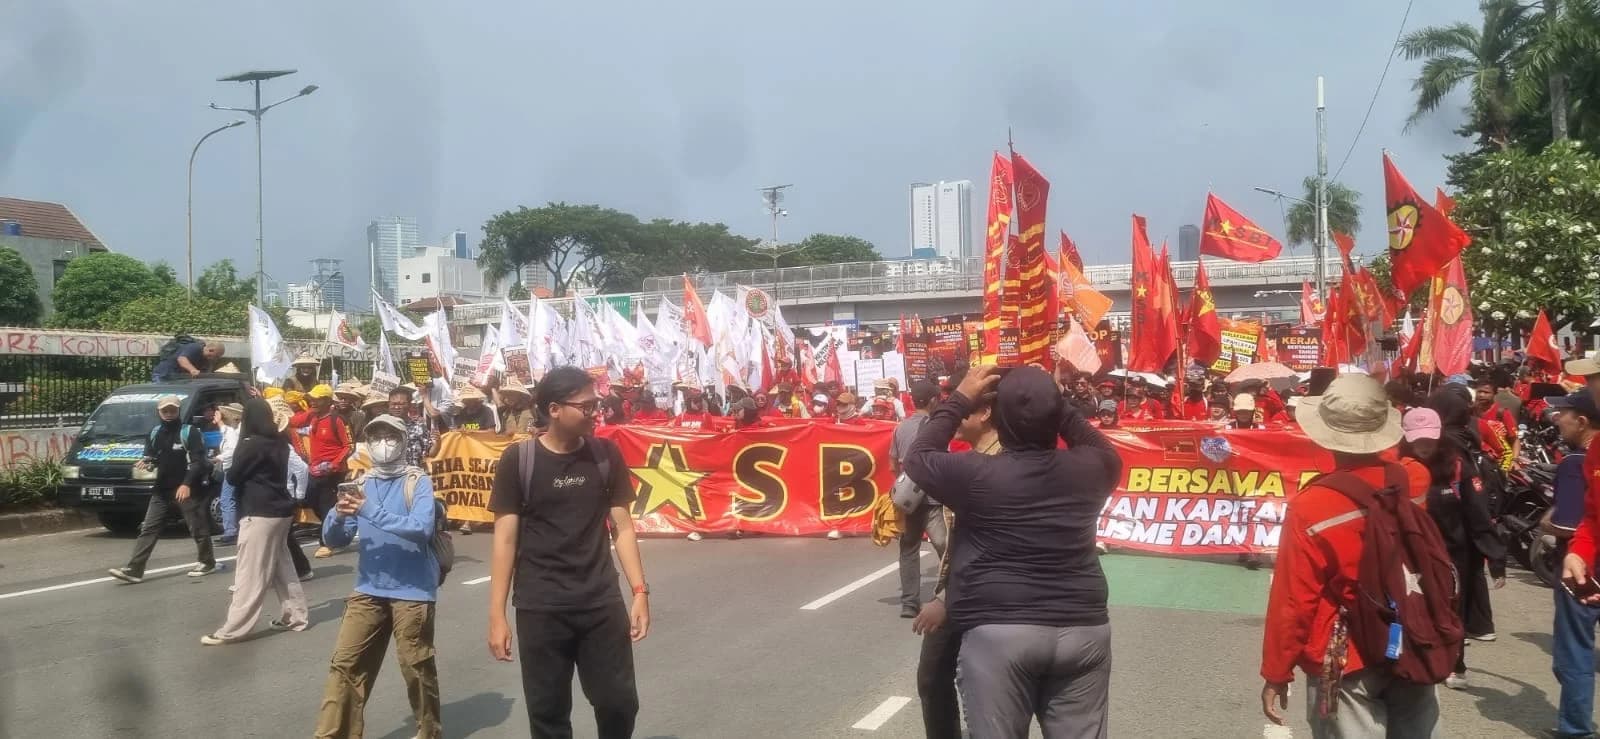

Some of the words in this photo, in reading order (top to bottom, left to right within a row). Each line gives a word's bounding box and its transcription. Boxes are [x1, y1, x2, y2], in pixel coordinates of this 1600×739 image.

[926, 323, 962, 334] HAPUS
[1281, 336, 1319, 345] KERJA
[1127, 467, 1285, 497] BERSAMA
[1100, 496, 1158, 520] AN
[1181, 522, 1248, 547] DAN
